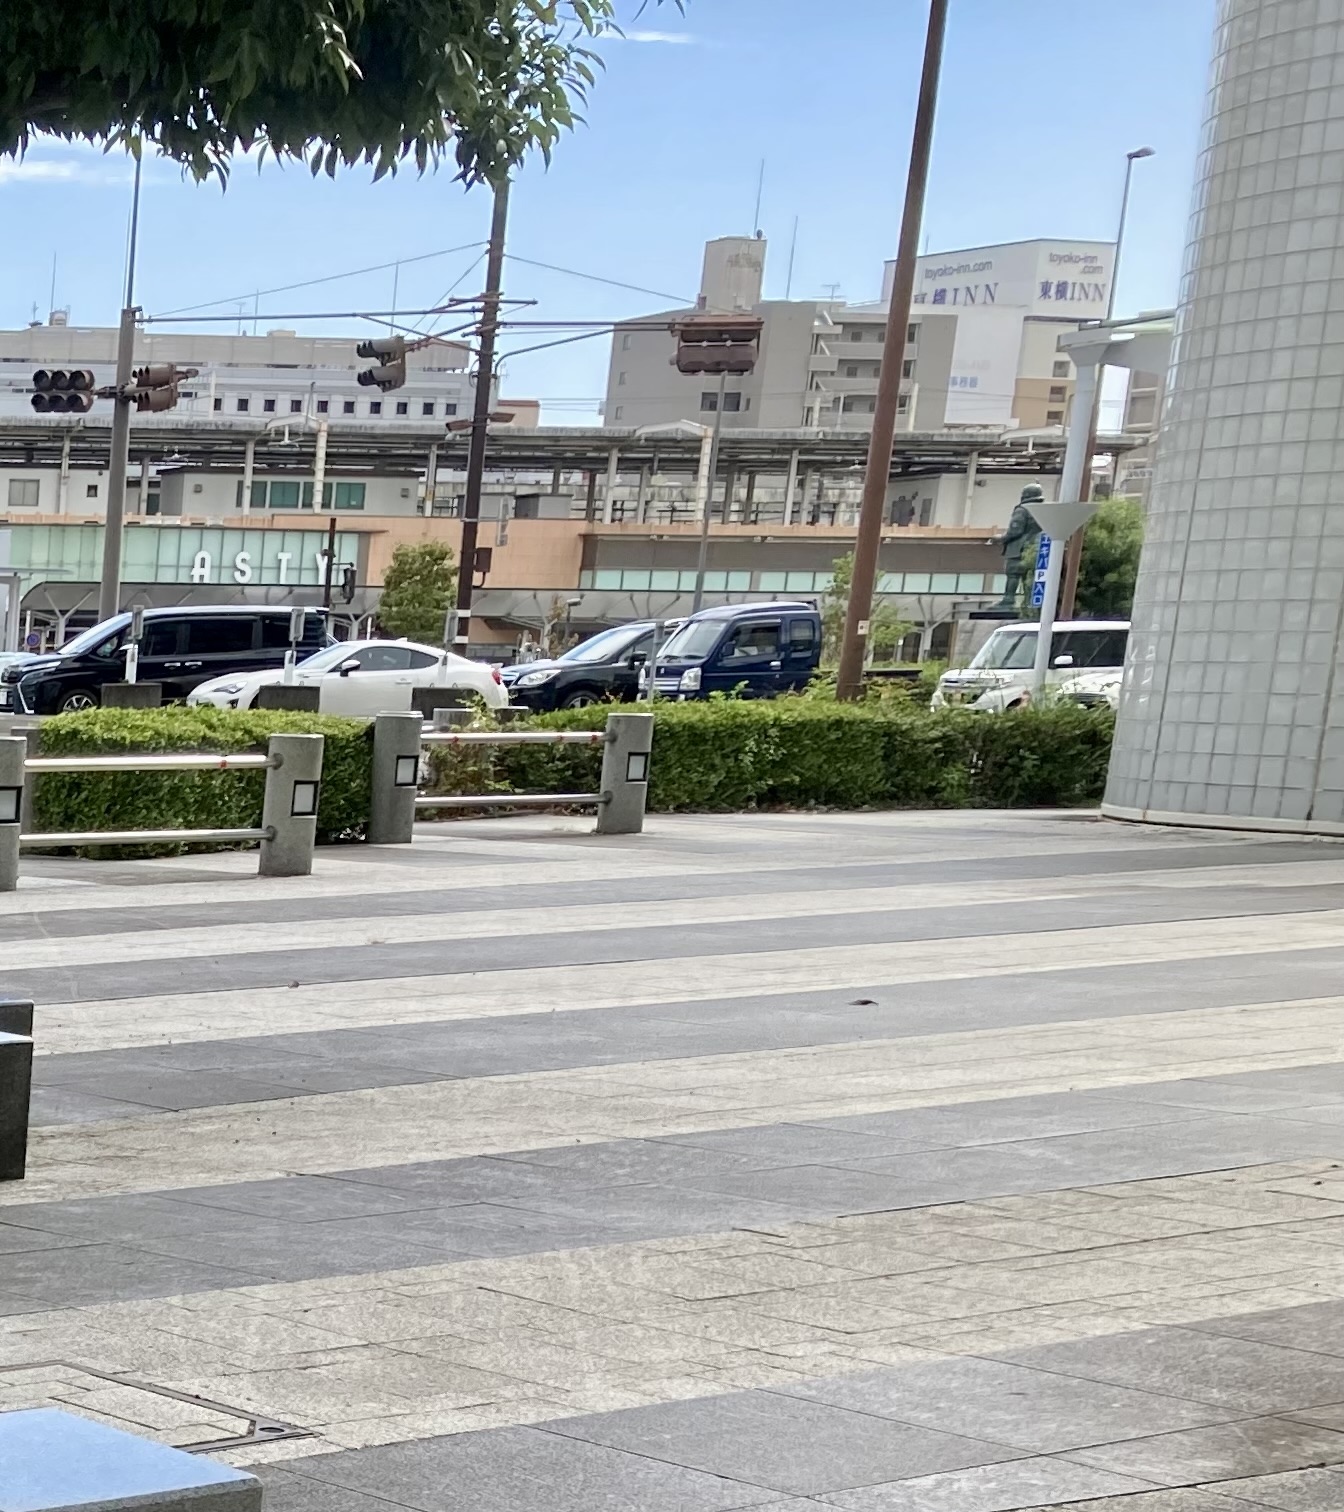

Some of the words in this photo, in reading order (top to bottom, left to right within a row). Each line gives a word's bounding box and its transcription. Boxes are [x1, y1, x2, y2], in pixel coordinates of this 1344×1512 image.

[1048, 251, 1098, 266] toyoko-inn
[924, 260, 993, 280] toyoko-inn.com
[1038, 279, 1107, 302] 東横INN
[190, 550, 333, 585] ASTY
